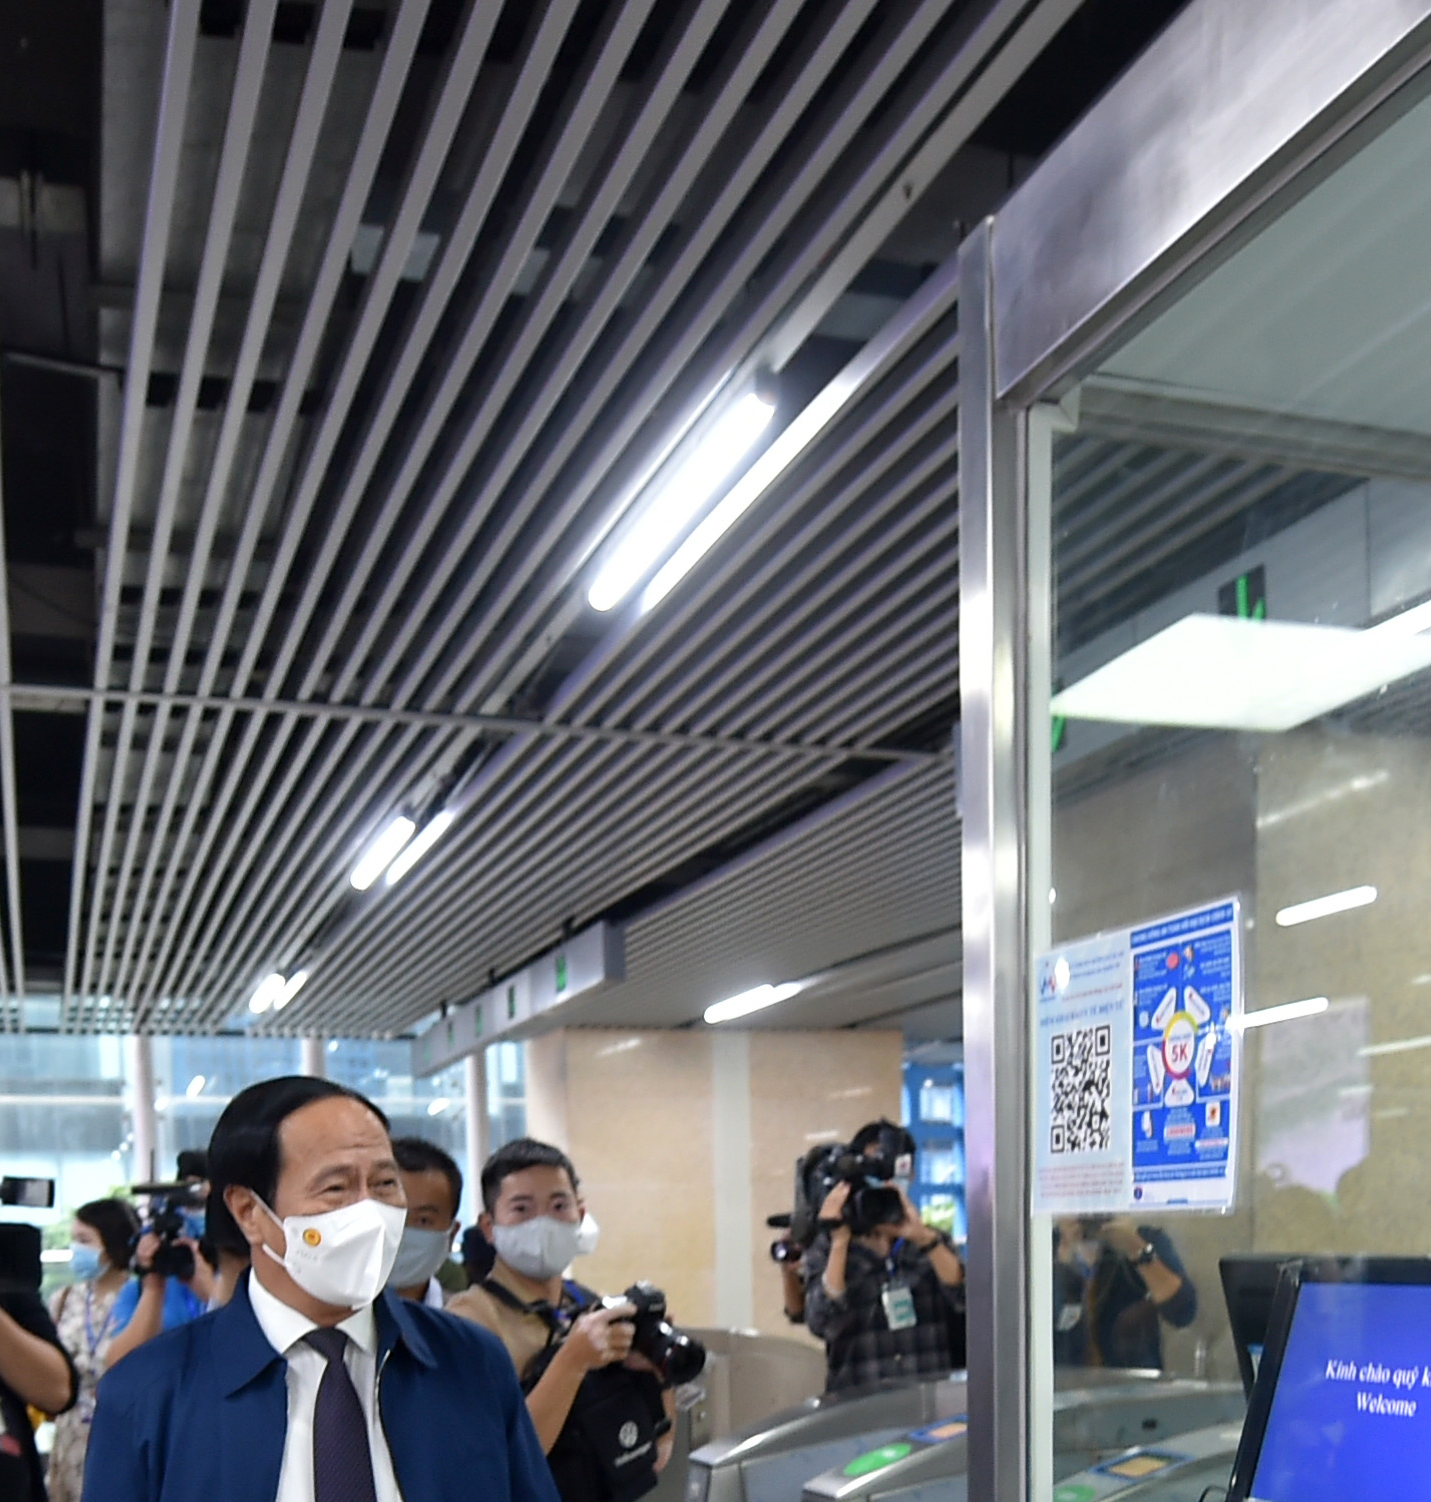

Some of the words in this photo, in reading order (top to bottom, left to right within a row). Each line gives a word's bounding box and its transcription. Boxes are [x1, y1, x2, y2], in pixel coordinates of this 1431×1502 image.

[1171, 1042, 1188, 1063] 5K
[1325, 1359, 1357, 1381] Kính
[1359, 1362, 1390, 1384] chào
[1392, 1366, 1419, 1390] quý
[1356, 1391, 1417, 1417] Welcome
